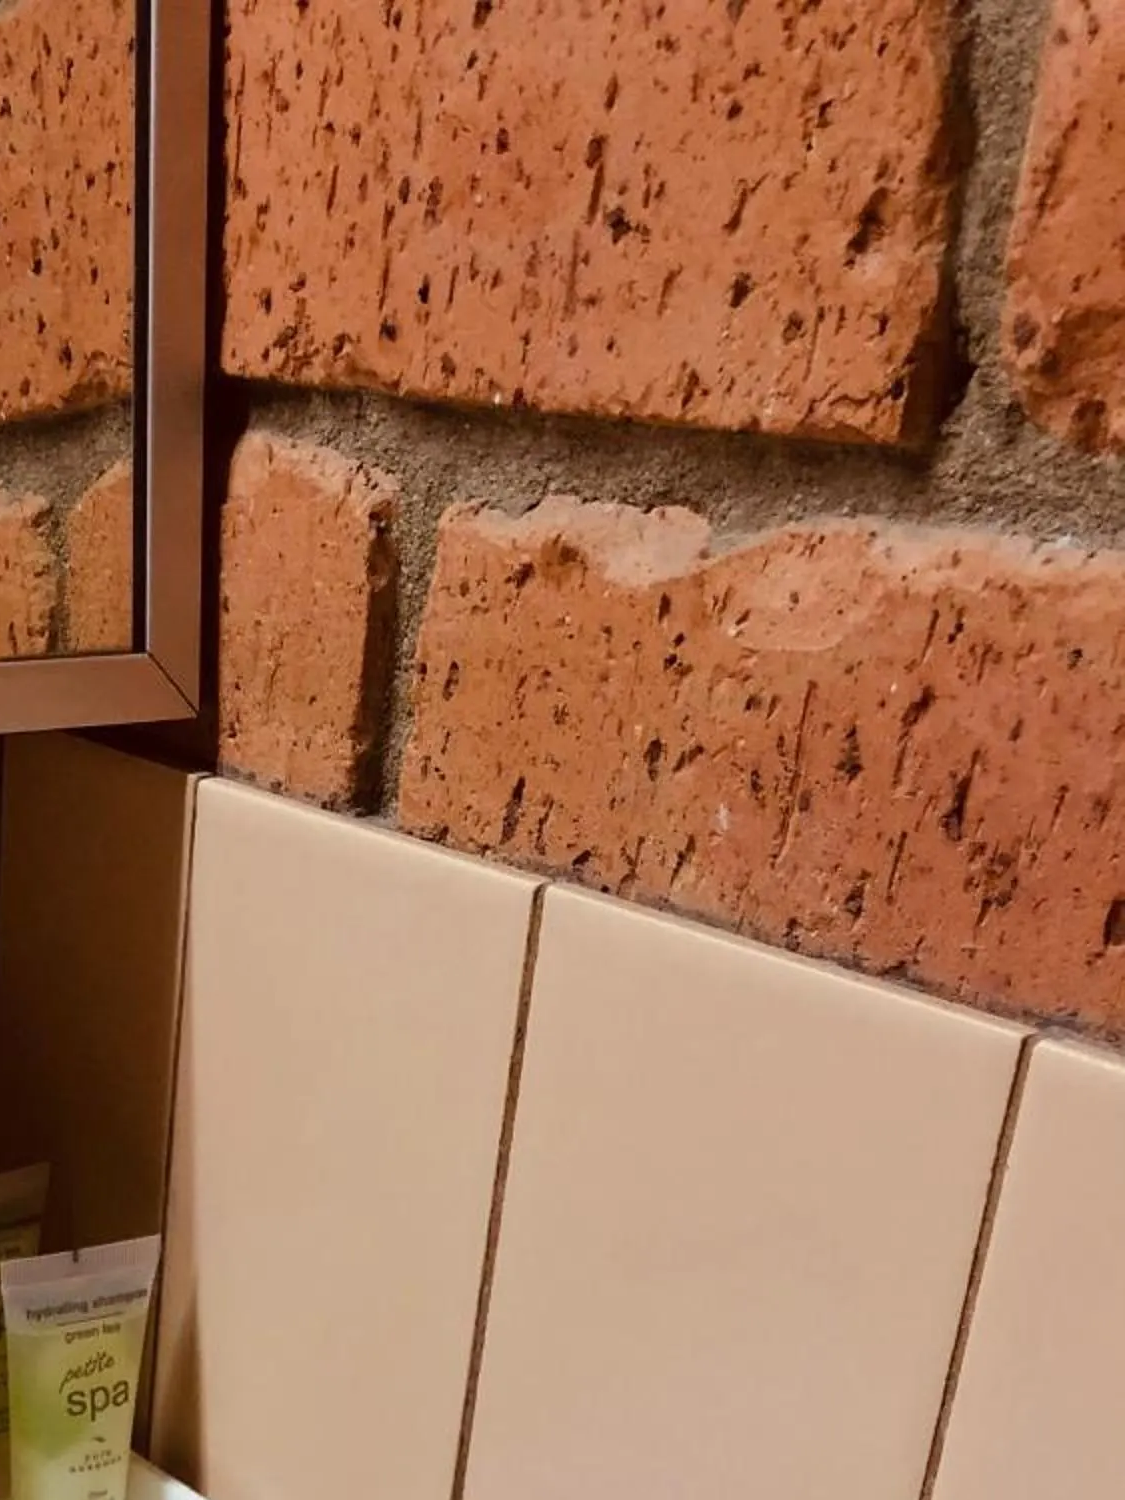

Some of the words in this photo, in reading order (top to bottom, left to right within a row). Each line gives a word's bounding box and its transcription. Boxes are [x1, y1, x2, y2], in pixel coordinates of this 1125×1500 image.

[26, 1300, 89, 1322] hydrating
[64, 1327, 100, 1345] green
[59, 1352, 115, 1394] petite
[66, 1379, 130, 1422] spa
